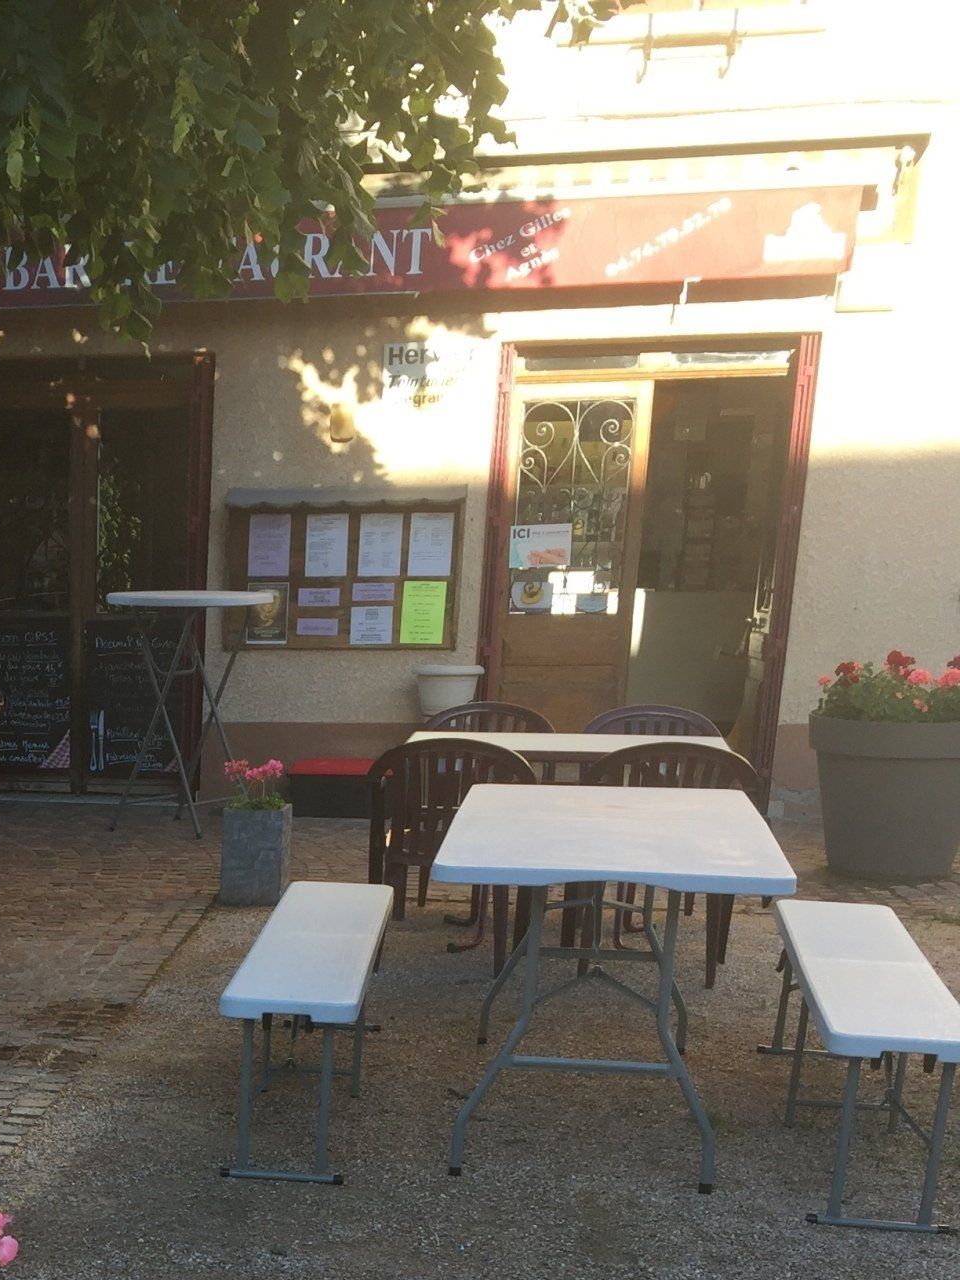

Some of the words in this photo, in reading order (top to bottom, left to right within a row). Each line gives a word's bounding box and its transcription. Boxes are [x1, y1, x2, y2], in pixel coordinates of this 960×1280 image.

[468, 234, 516, 265] Chez
[520, 242, 538, 258] et
[2, 245, 92, 290] BAR
[512, 528, 531, 539] ICI
